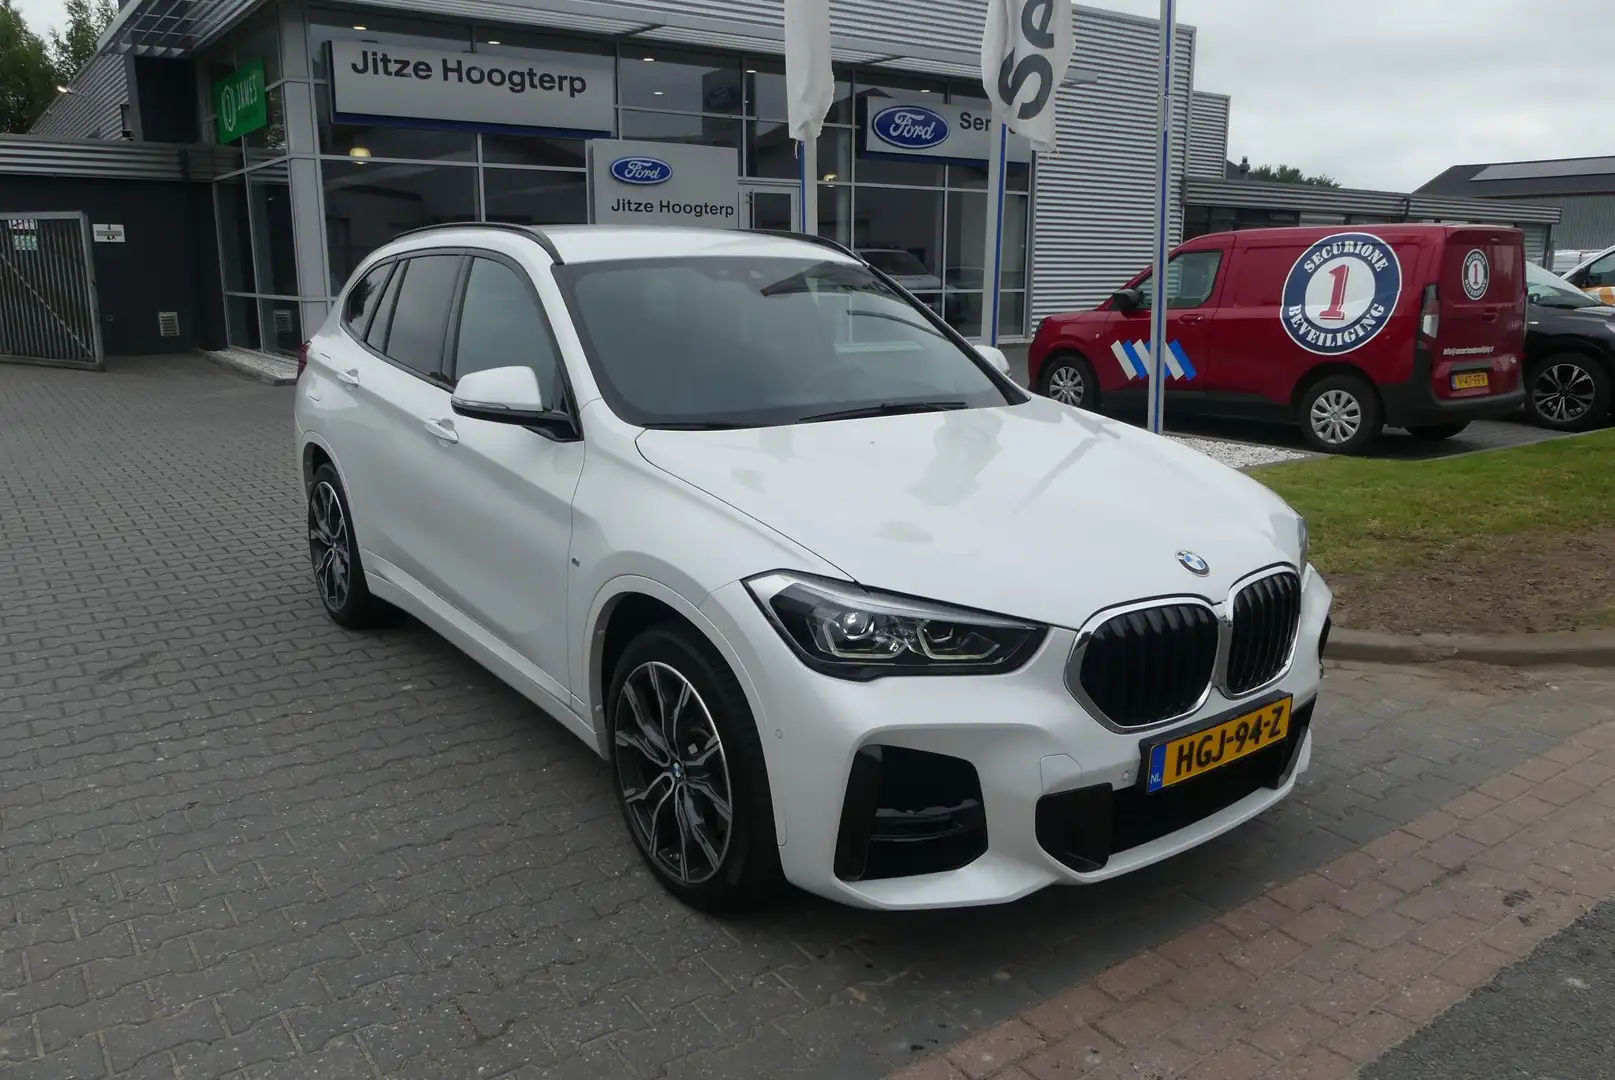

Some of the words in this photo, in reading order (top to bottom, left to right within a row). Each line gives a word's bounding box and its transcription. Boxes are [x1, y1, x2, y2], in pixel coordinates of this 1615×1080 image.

[351, 50, 433, 80] Jitze
[441, 58, 587, 98] Hoogterp
[236, 74, 257, 111] JAMES
[889, 111, 936, 140] Ford
[959, 111, 992, 132] Ser
[624, 160, 661, 180] Ford
[611, 198, 654, 213] Jitze
[659, 200, 734, 217] Hoogterp
[1304, 240, 1389, 273] SECURIONE
[1473, 263, 1480, 286] 1
[1319, 264, 1350, 320] 1
[1288, 303, 1386, 347] BEVEILIGING
[1176, 705, 1284, 776] HGJ-94-Z
[1150, 773, 1161, 784] NL
